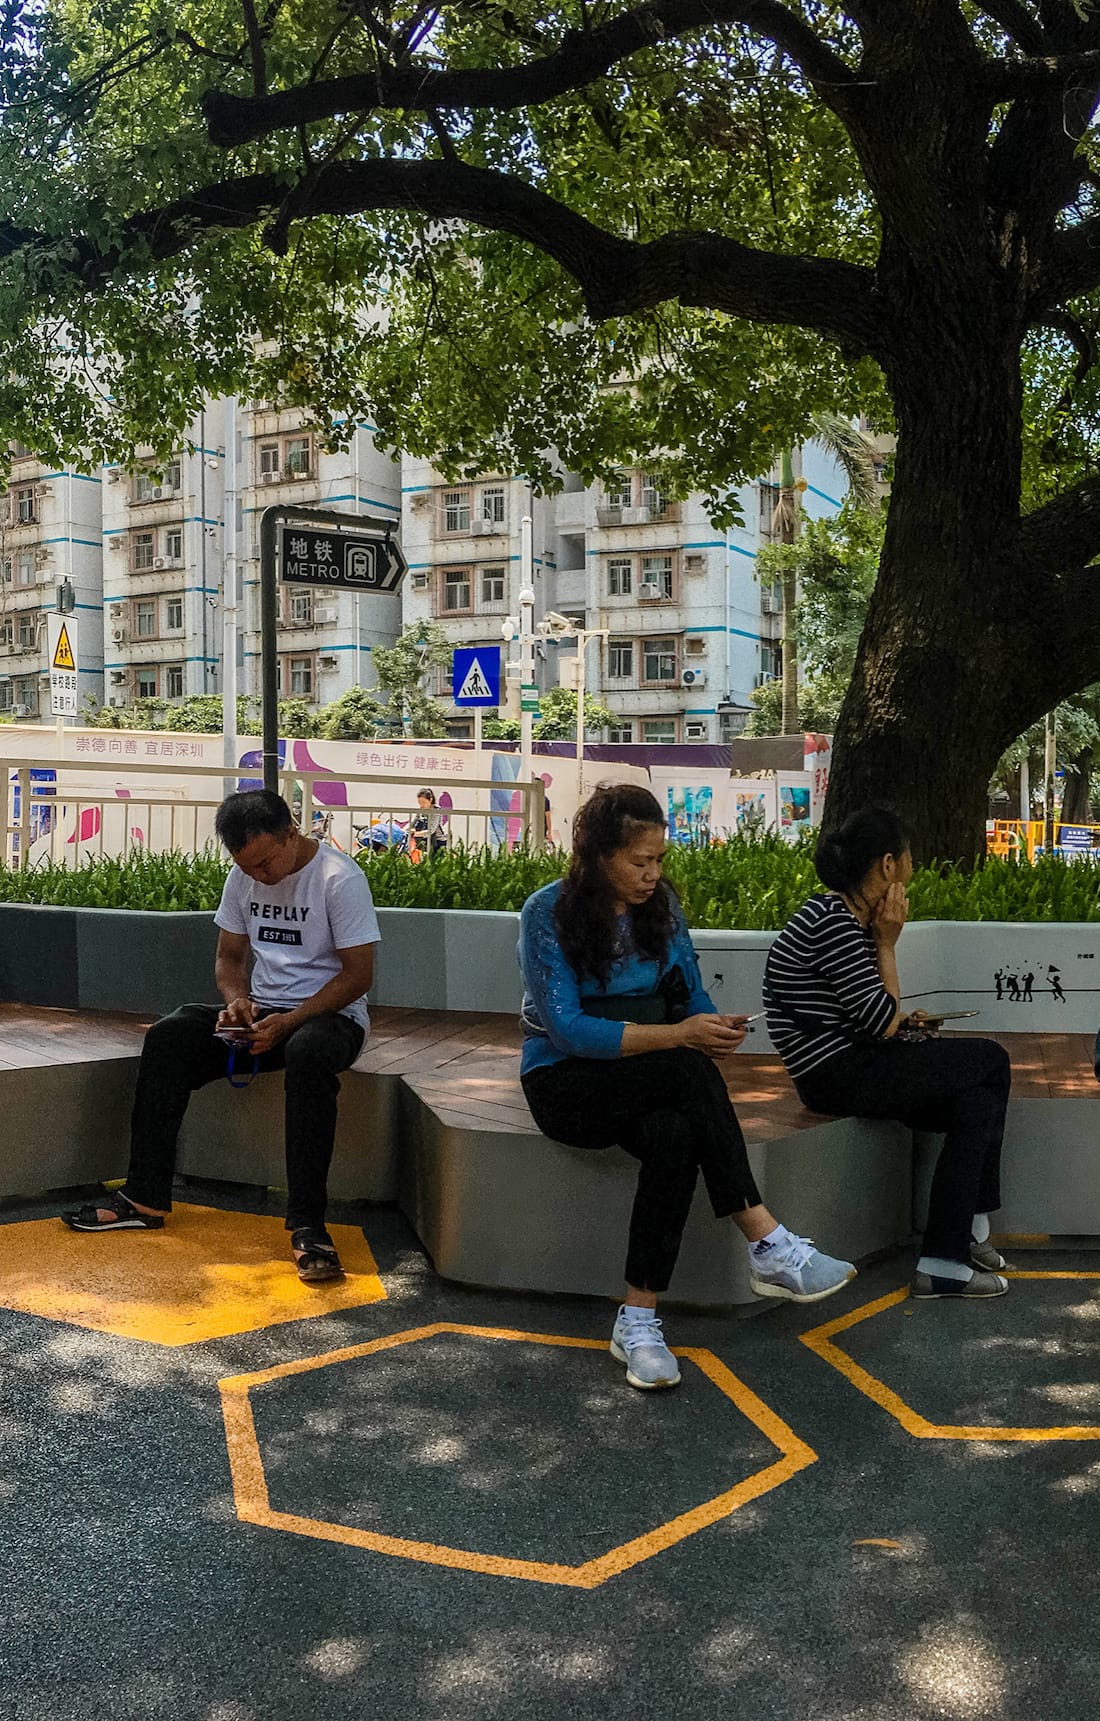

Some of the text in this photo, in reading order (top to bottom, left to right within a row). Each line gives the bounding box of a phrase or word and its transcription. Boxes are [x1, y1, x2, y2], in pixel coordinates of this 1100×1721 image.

[290, 537, 333, 562] 地铁
[287, 561, 340, 579] METRO
[53, 696, 77, 711] 注意行人
[76, 737, 204, 758] 崇德向善 宜居深圳
[356, 751, 464, 772] 绿色出行 健康生活
[250, 902, 310, 922] REPLAY
[263, 930, 280, 940] EST
